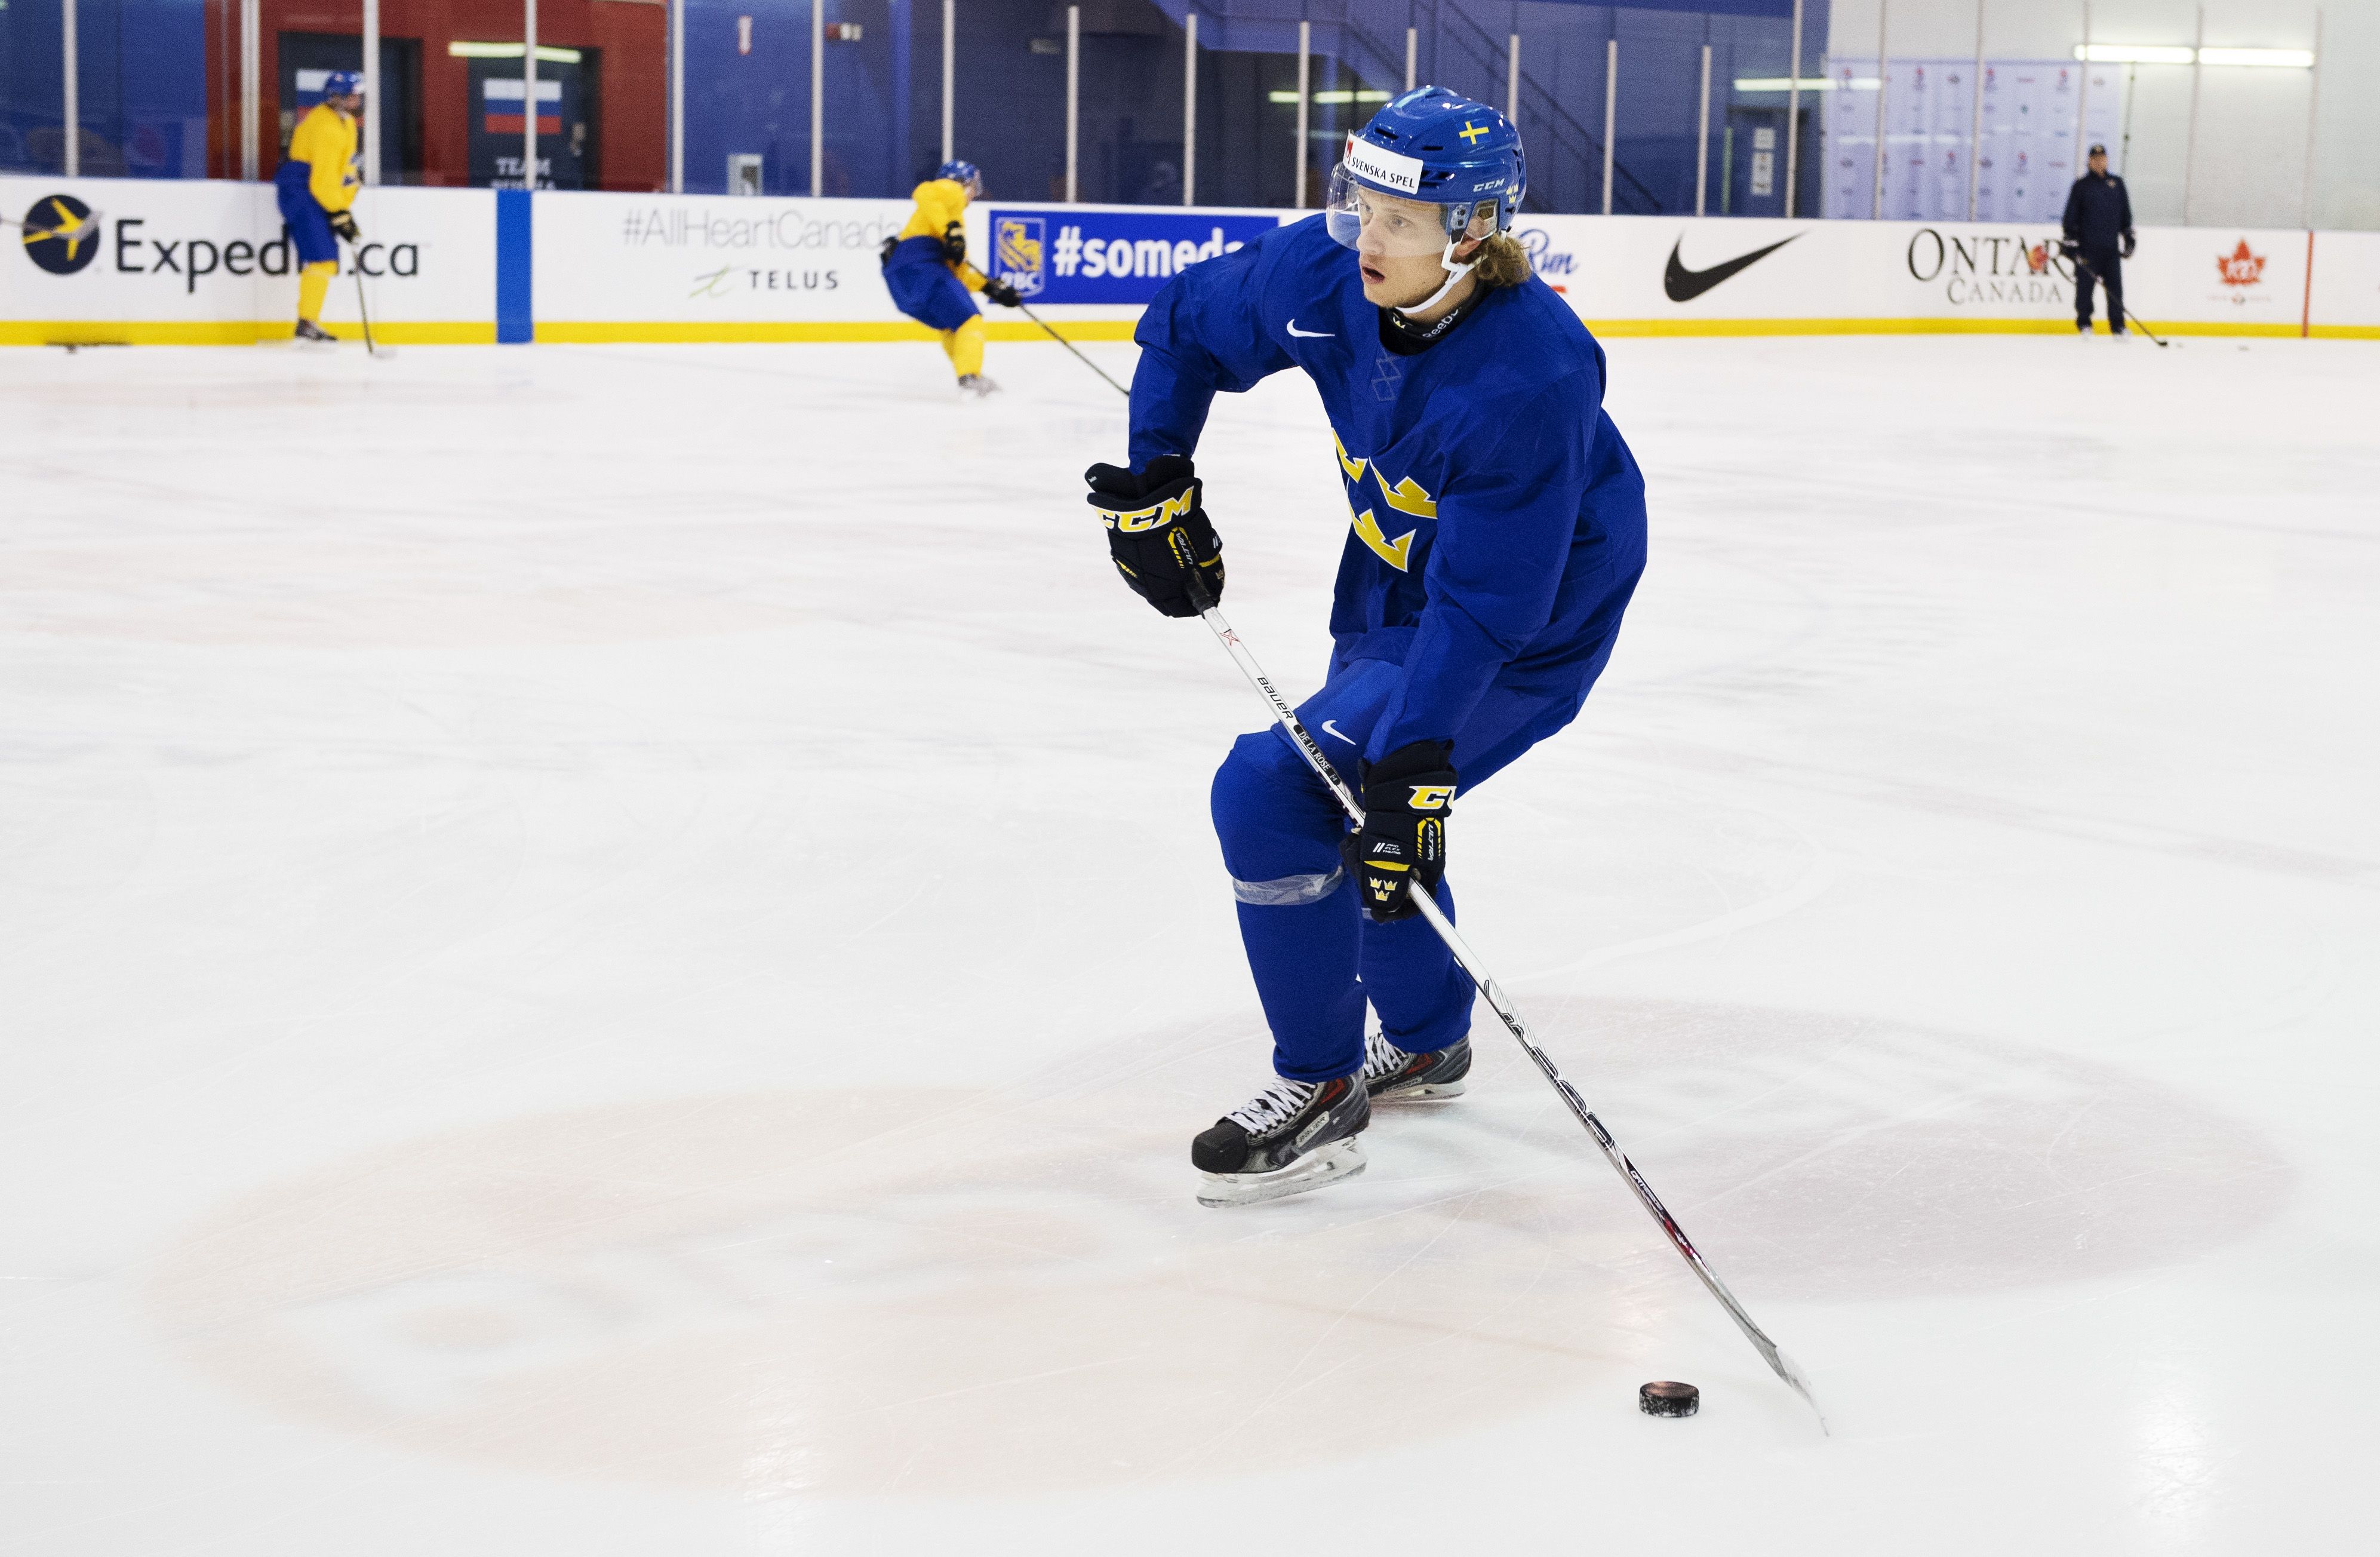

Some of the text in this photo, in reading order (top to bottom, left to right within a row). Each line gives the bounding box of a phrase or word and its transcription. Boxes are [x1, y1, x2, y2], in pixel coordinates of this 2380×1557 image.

[1351, 156, 1415, 189] SVENSKA SPEL
[1472, 177, 1505, 192] CCM
[115, 219, 419, 294] Exped.ca
[1052, 225, 1244, 278] #somed
[1907, 228, 2077, 284] ONTAR
[749, 270, 839, 290] TELUS
[1947, 277, 2064, 305] CANADA
[1256, 677, 1294, 719] BAUER
[1298, 732, 1310, 743] DE
[1306, 741, 1316, 753] LA
[1313, 752, 1331, 771] ROSE
